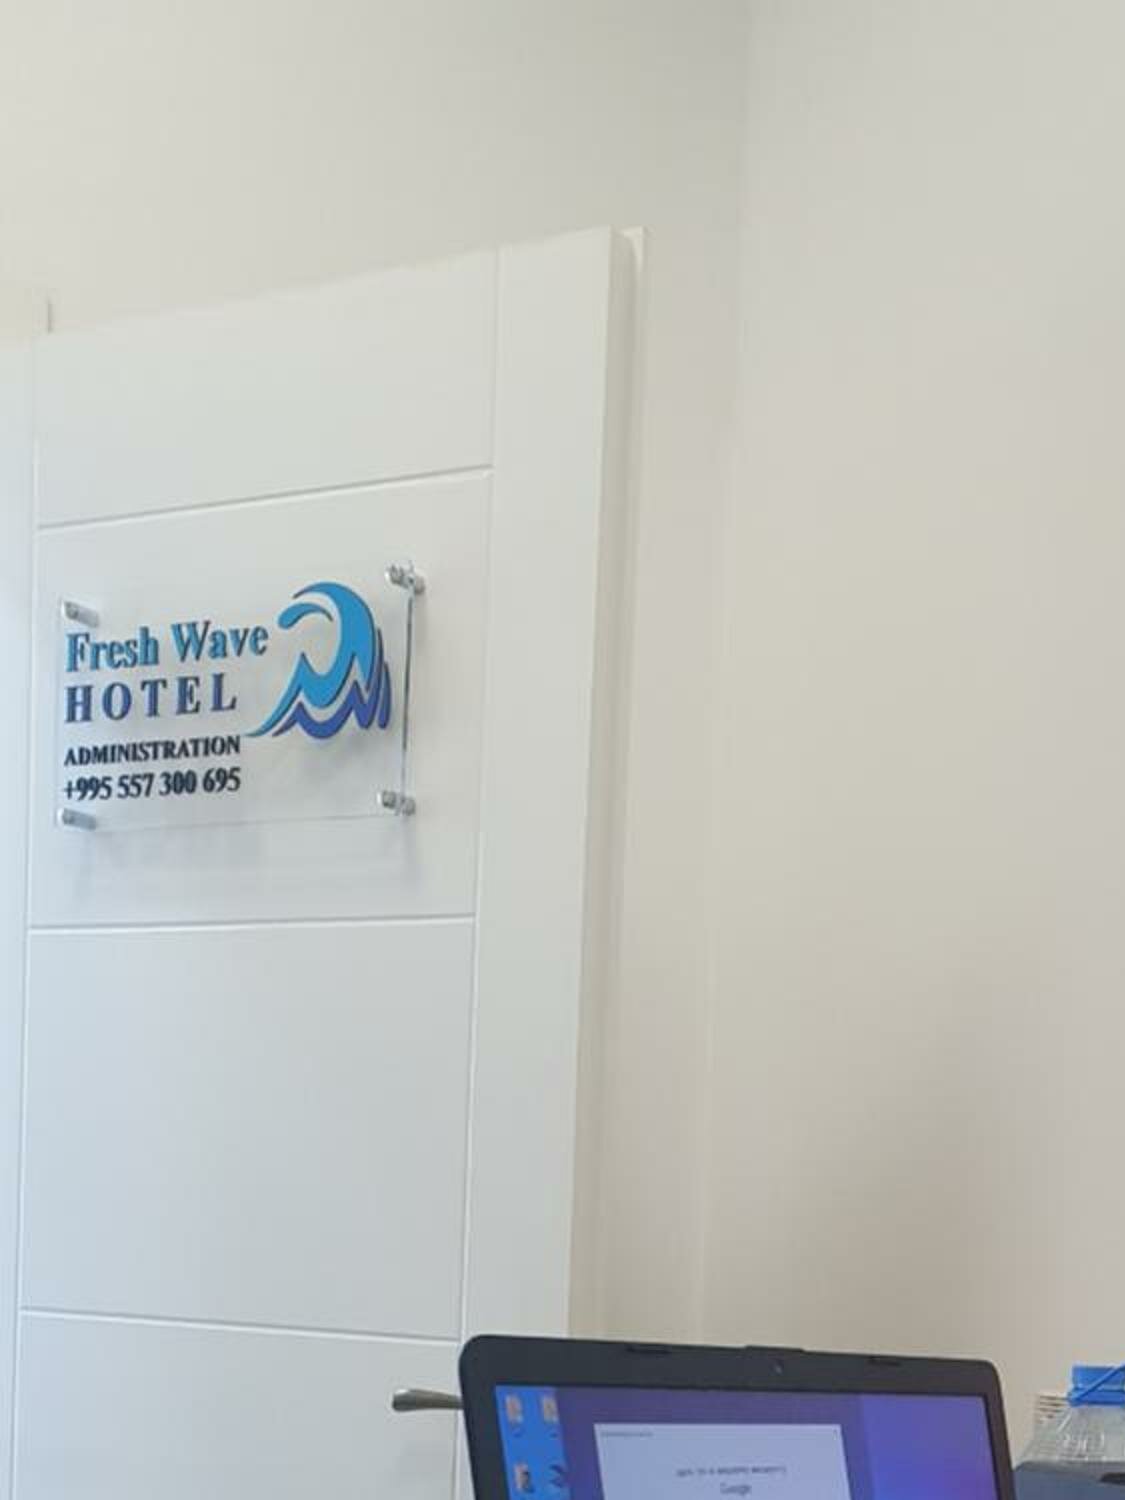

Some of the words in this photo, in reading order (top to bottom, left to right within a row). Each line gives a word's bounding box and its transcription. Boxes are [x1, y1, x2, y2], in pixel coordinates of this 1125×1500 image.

[65, 625, 161, 673] Fresh
[170, 619, 269, 663] Wave
[65, 672, 238, 723] HOTEL
[64, 735, 241, 767] ADMINISTRATION
[64, 774, 112, 800] +995
[117, 772, 155, 798] 557
[159, 769, 197, 796] 300
[202, 766, 241, 794] 695
